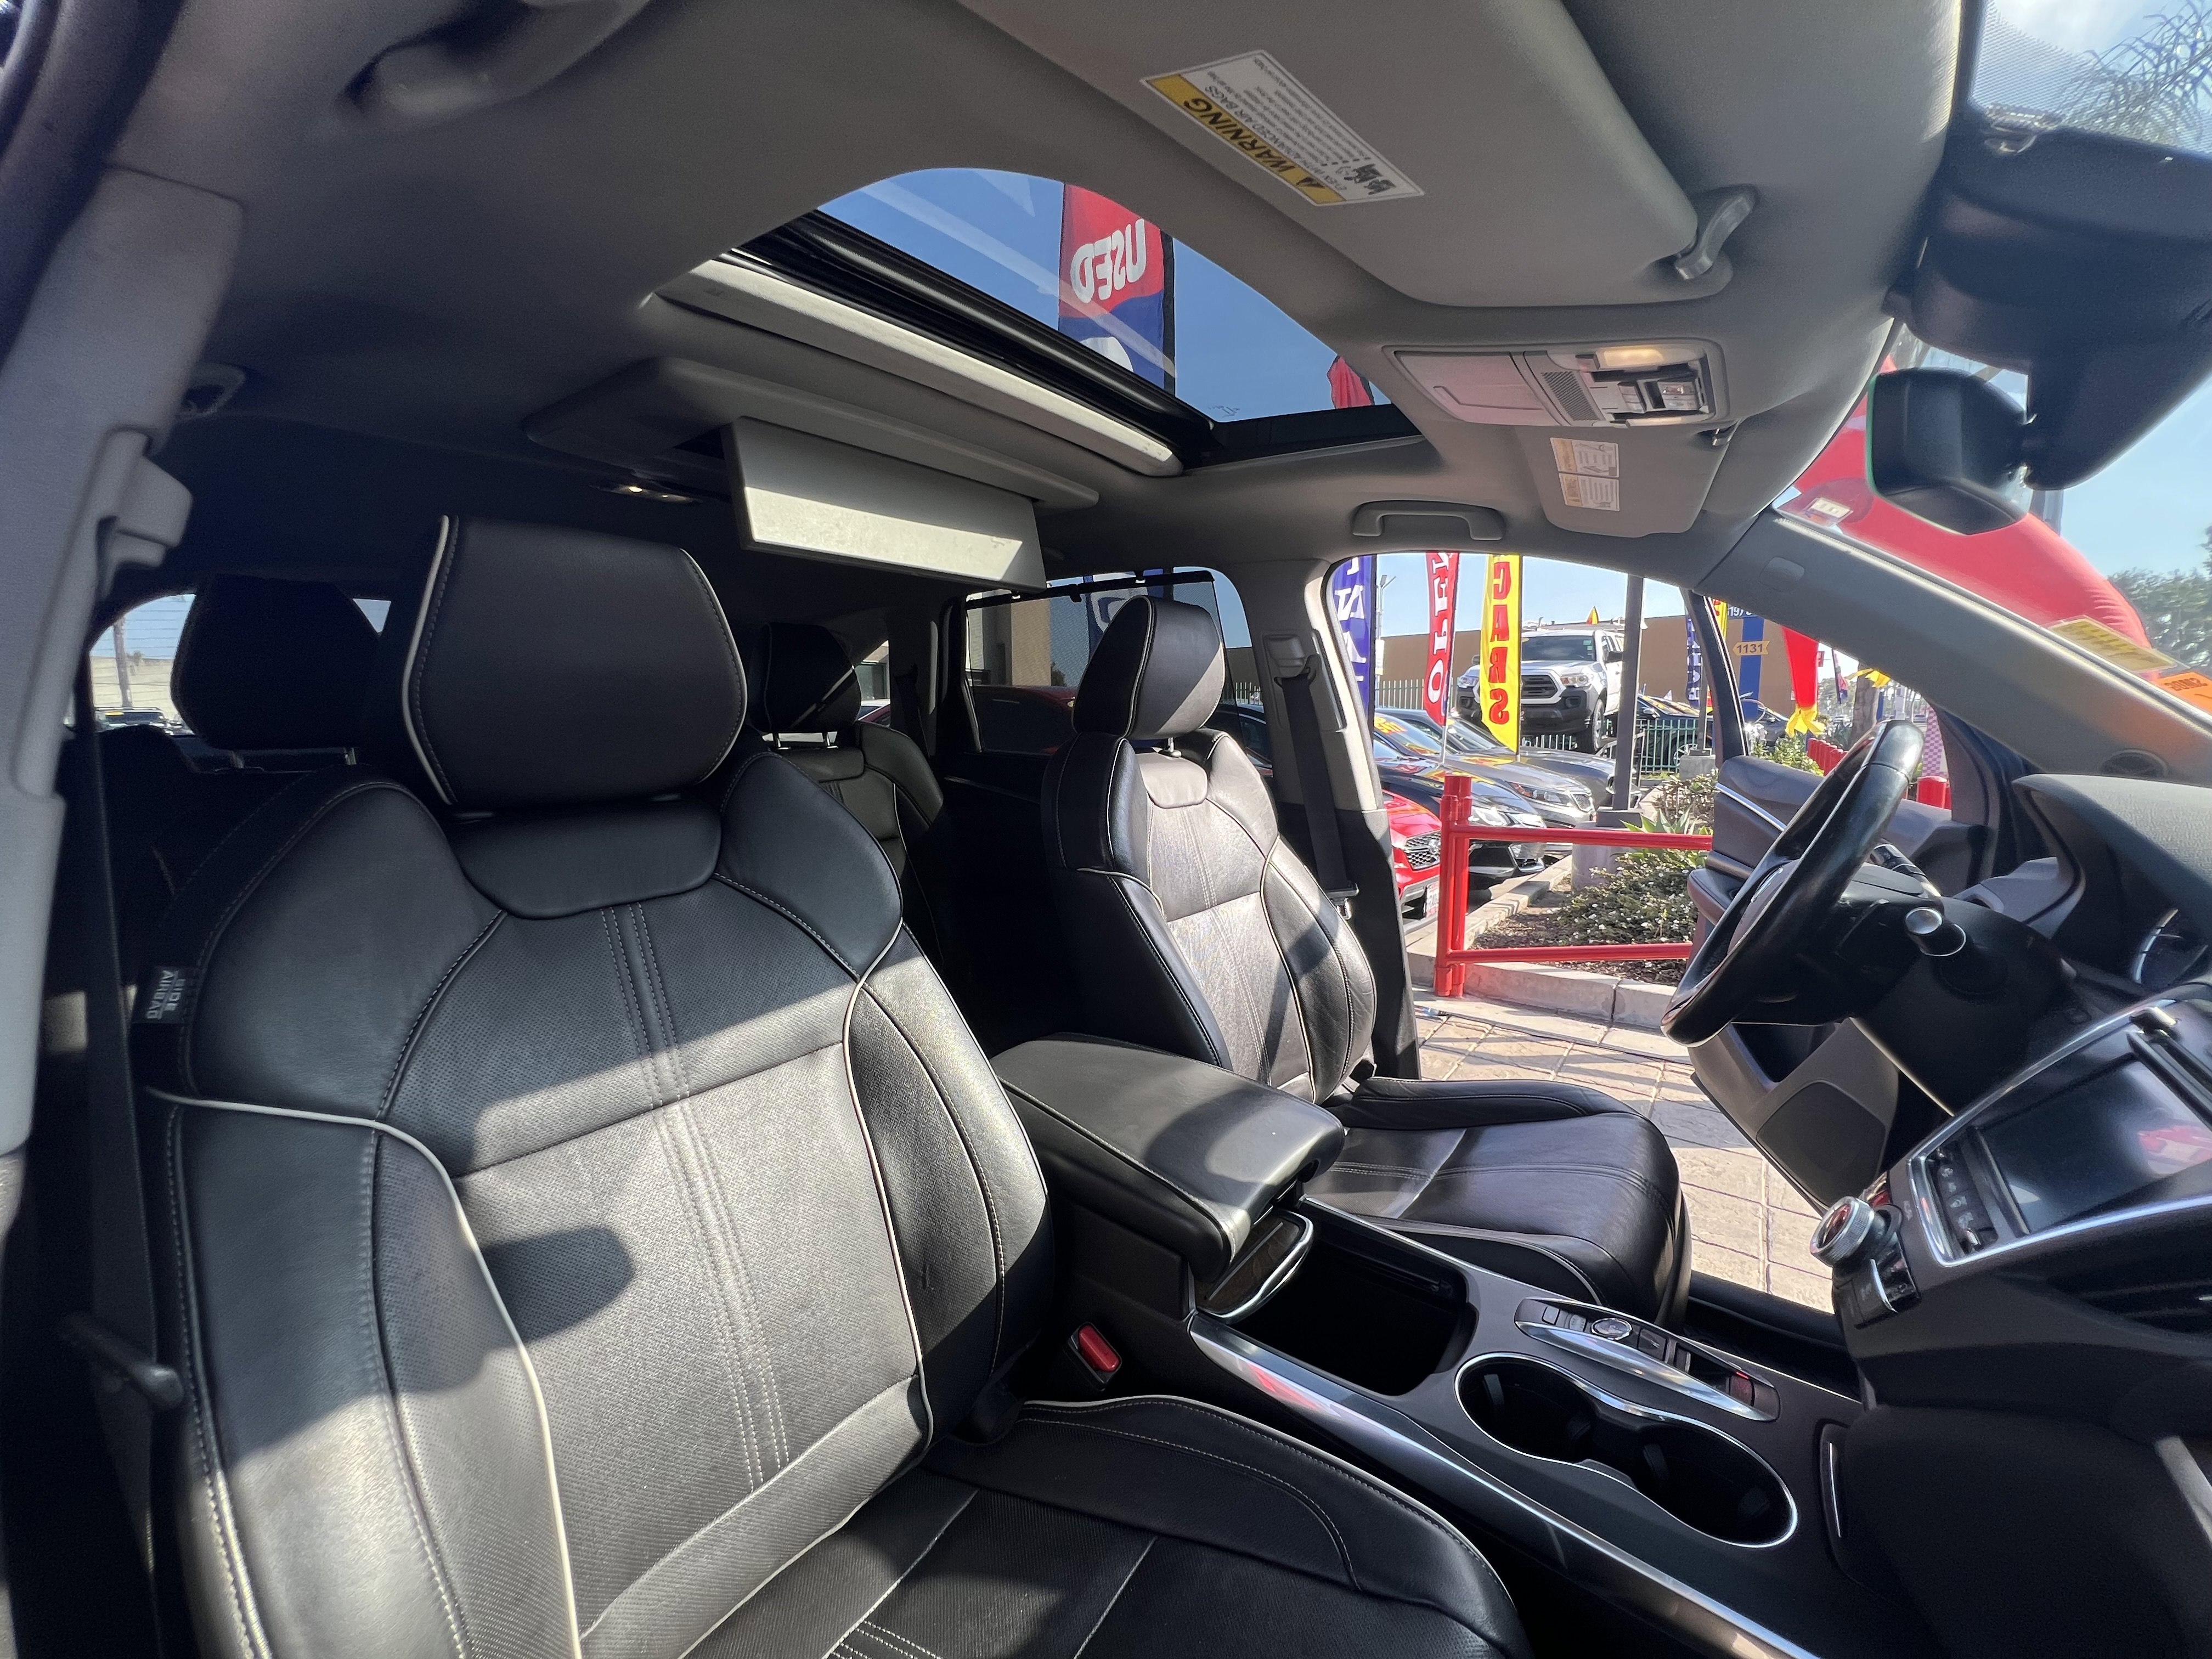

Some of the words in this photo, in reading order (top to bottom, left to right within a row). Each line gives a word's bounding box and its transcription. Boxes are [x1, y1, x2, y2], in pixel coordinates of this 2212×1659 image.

[1204, 84, 1240, 111] BAGS
[1183, 97, 1296, 172] WARNING
[1736, 644, 1763, 653] 1131
